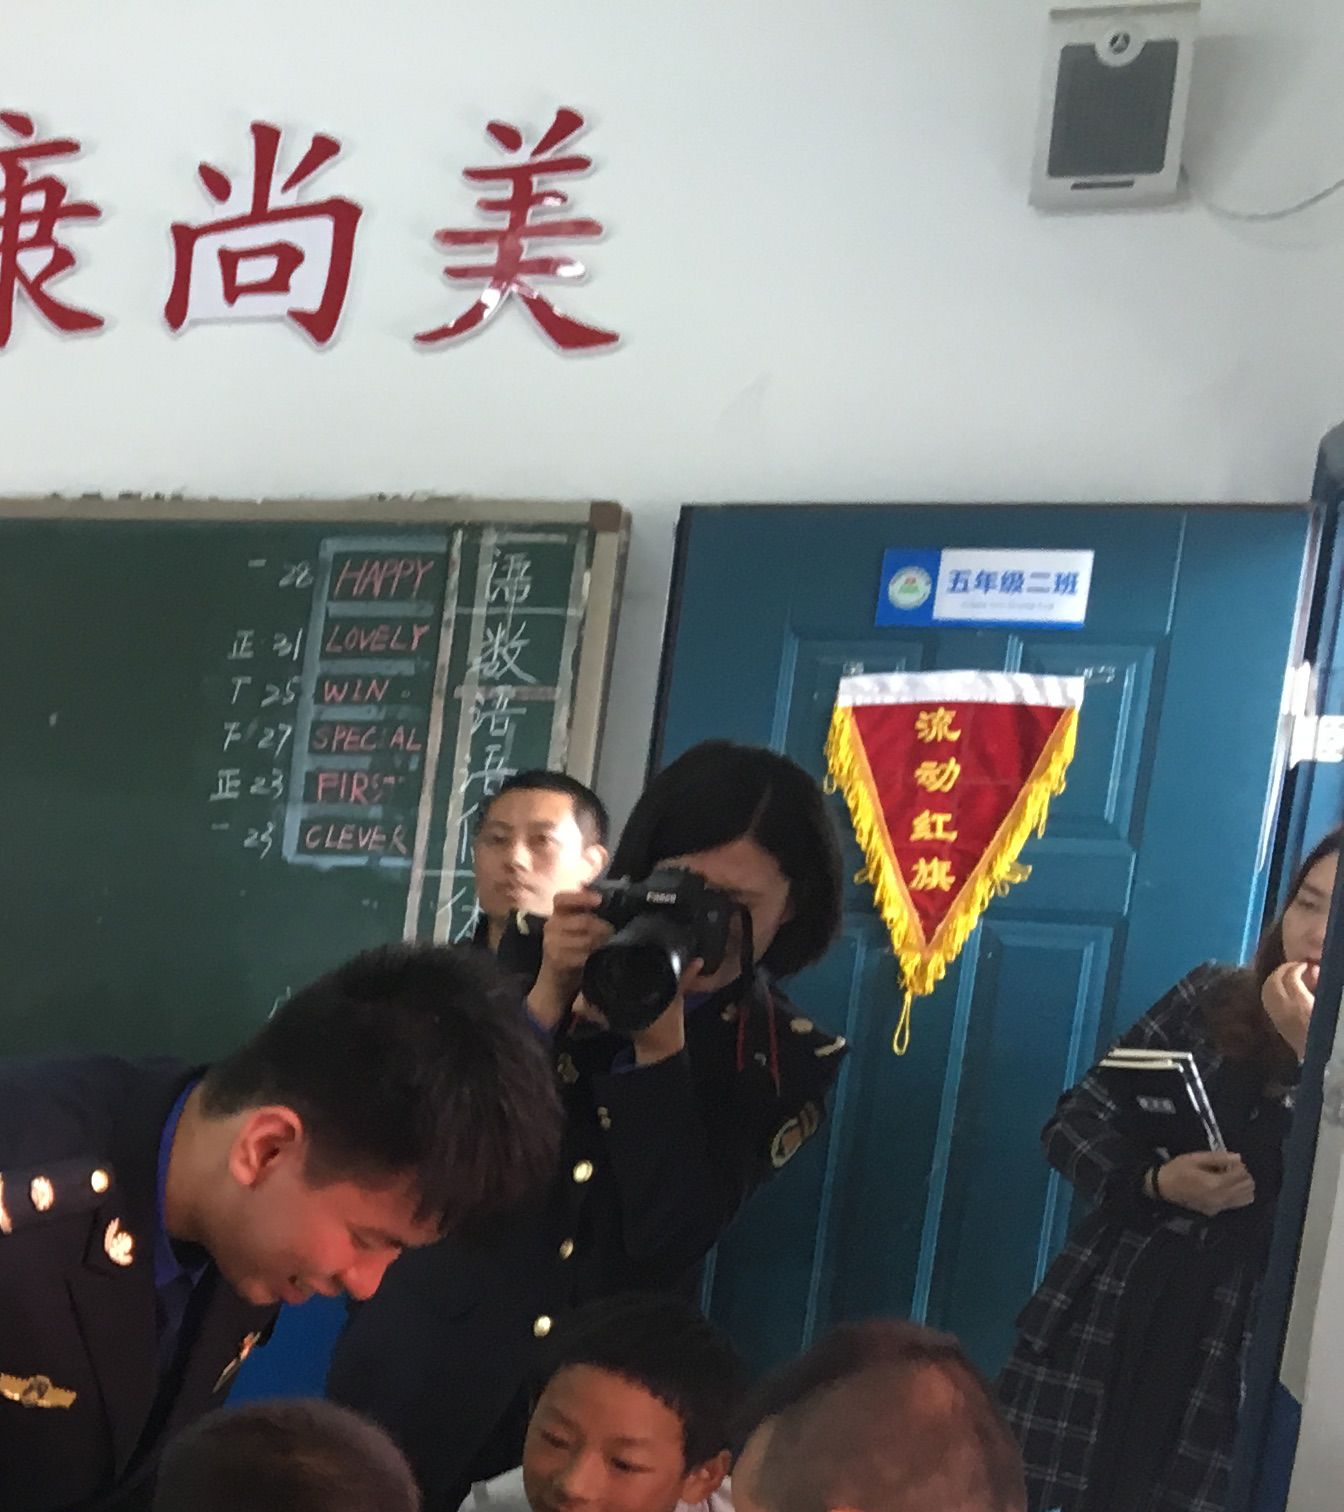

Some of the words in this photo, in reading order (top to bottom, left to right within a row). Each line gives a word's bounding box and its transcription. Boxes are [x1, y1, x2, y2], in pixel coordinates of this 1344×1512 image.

[333, 559, 434, 598] HAPPY
[947, 569, 1079, 595] 五年级二班
[325, 624, 430, 652] LOVELY
[324, 679, 390, 703] WIN
[258, 723, 292, 758] 27
[910, 707, 962, 892] 流动红旗
[305, 823, 408, 855] CLEVER
